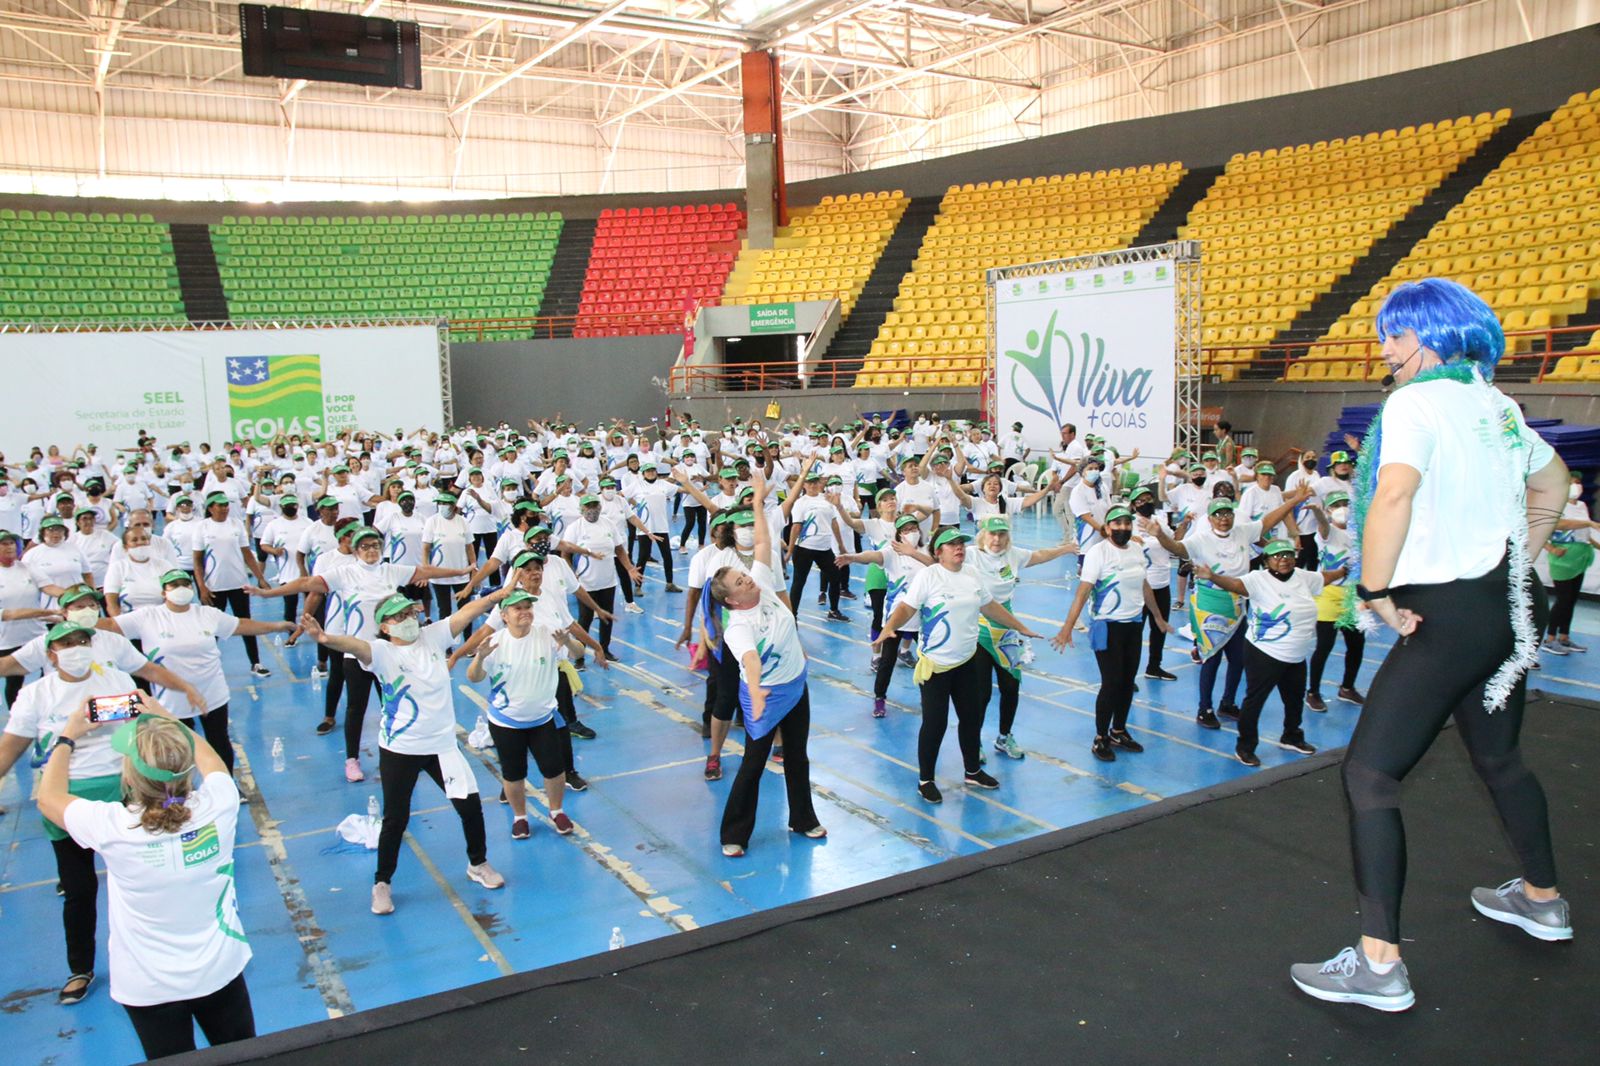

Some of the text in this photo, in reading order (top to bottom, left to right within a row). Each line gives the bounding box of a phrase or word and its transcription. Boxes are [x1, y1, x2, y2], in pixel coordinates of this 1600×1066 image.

[757, 308, 778, 317] SAÍDA
[751, 317, 794, 326] EMERGÊNCIA
[1077, 332, 1153, 408] Viva
[143, 391, 184, 404] SEEL
[326, 394, 356, 403] É POR
[326, 402, 353, 413] VOCÊ
[74, 407, 185, 420] Secretaria de Estado
[327, 414, 348, 424] QUE
[1101, 407, 1147, 429] GOIÁS
[88, 423, 103, 432] de
[105, 421, 145, 431] Esporte
